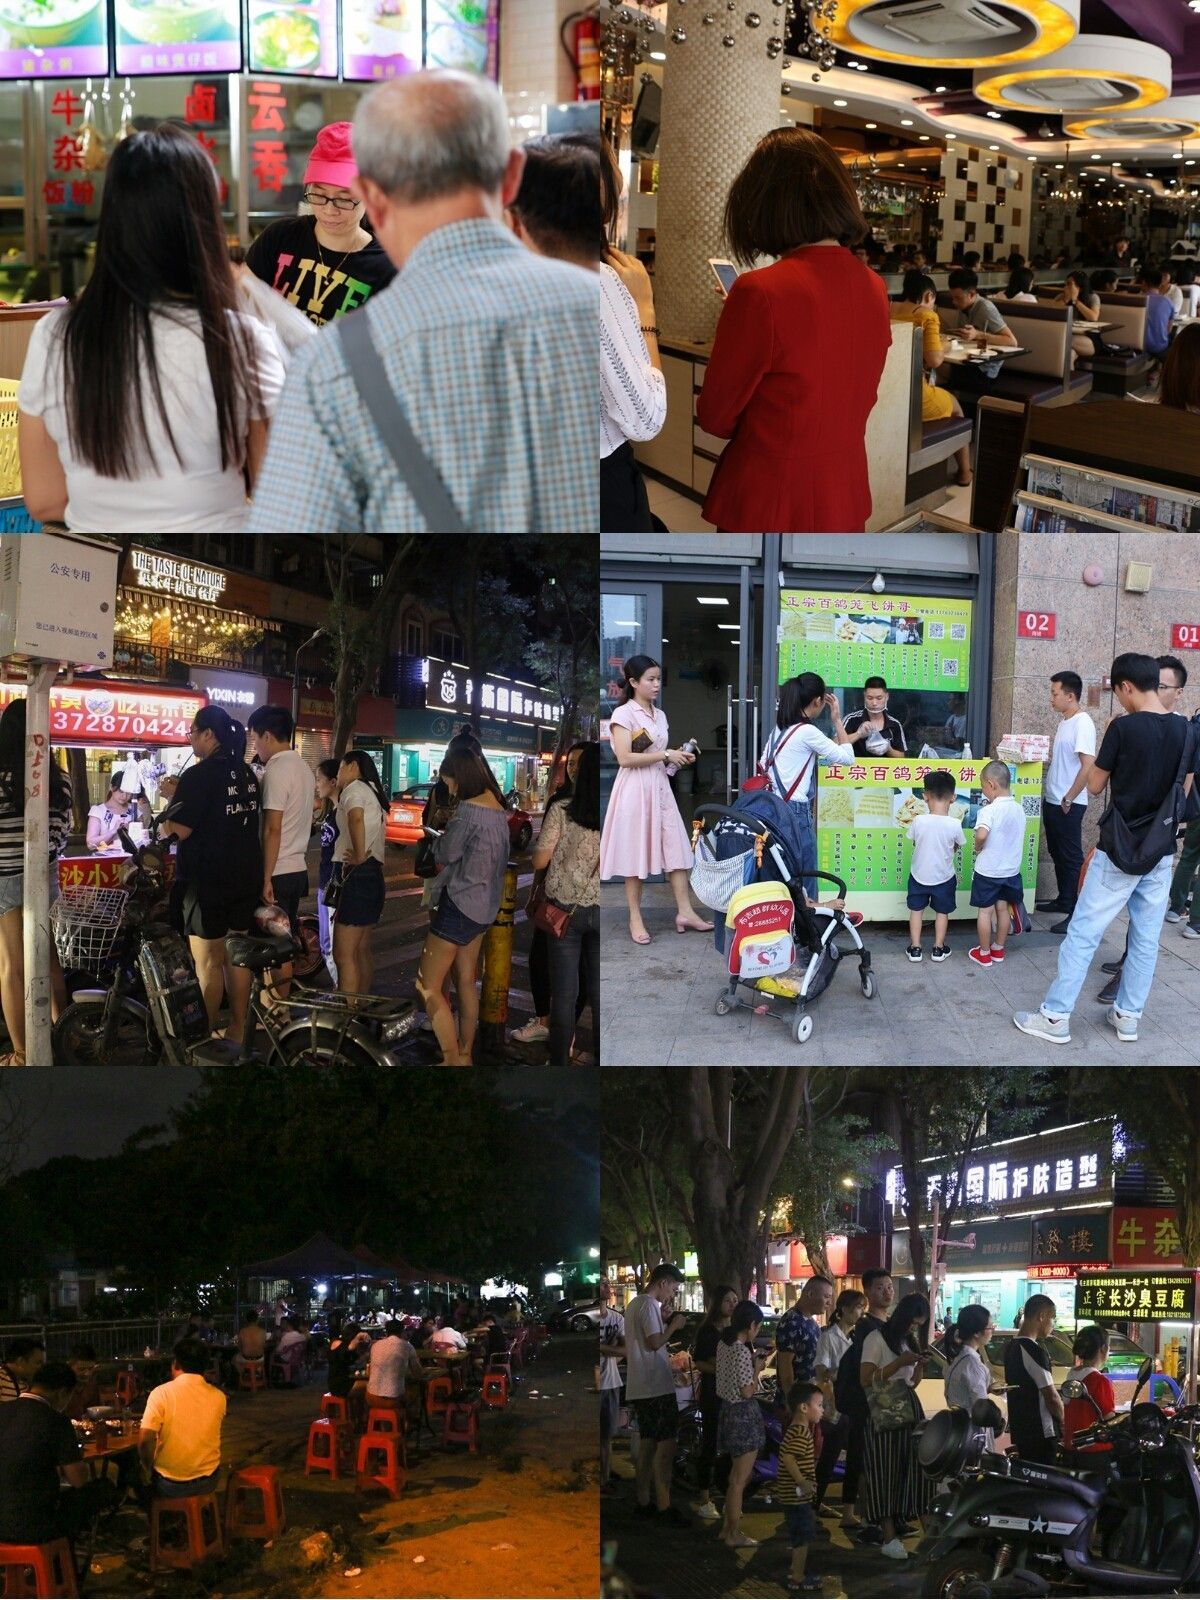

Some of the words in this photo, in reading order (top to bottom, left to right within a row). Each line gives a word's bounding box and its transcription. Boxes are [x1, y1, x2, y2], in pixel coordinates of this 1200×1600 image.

[272, 253, 372, 320] LIVE
[50, 562, 91, 582] 公安专用
[133, 551, 151, 572] THE
[153, 556, 181, 580] TASTE
[181, 563, 194, 582] OF
[193, 567, 226, 591] NATURE
[1025, 613, 1049, 631] 02
[1179, 626, 1199, 643] 01
[206, 687, 237, 703] YIXIN
[53, 711, 192, 737] 372870424
[825, 764, 977, 782] 正宗百鸽笼饼
[1116, 1217, 1181, 1258] 牛杂
[1083, 1288, 1185, 1309] 正宗长沙臭豆腐
